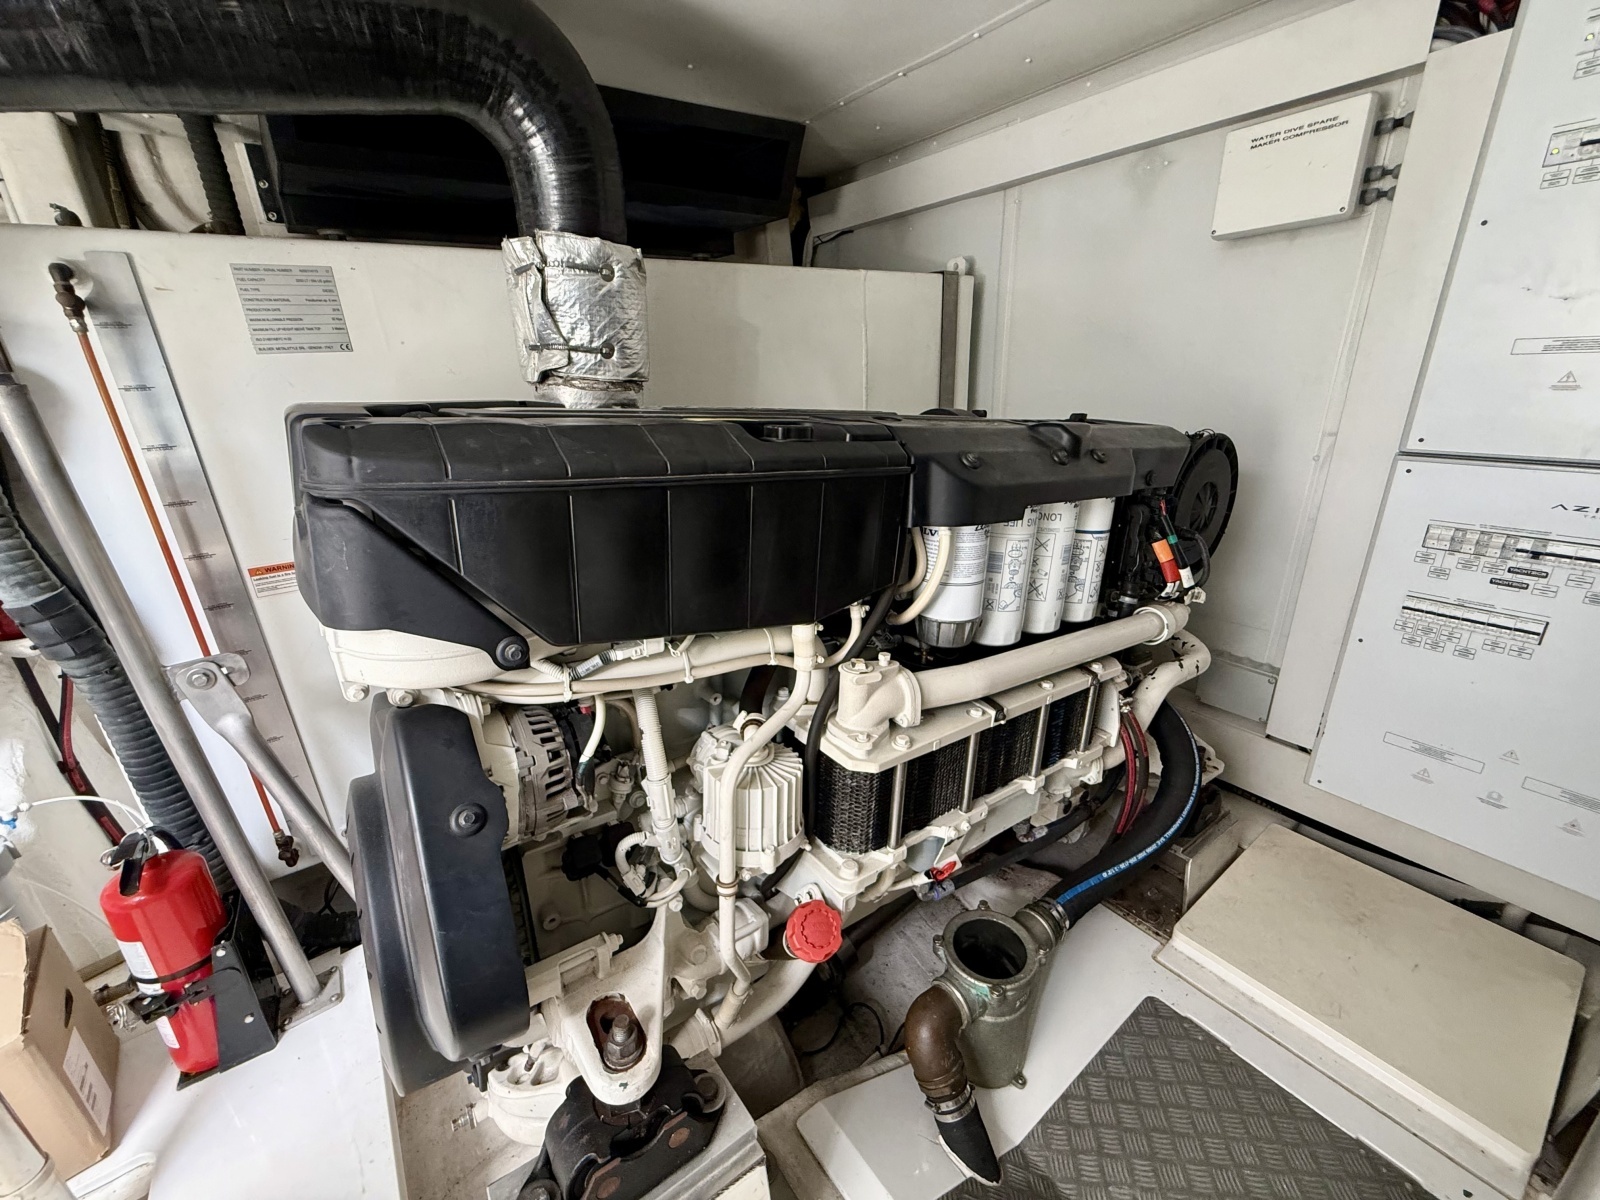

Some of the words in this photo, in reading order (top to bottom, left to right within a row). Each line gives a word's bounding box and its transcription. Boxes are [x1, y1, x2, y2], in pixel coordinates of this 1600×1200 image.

[1250, 138, 1281, 149] MAKER
[1282, 120, 1349, 141] COMPRESSOR
[1251, 131, 1282, 143] WATER
[1283, 124, 1305, 135] DIVE
[1307, 115, 1339, 128] SPARE
[1551, 503, 1600, 514] AZI
[264, 563, 295, 573] WARNIN
